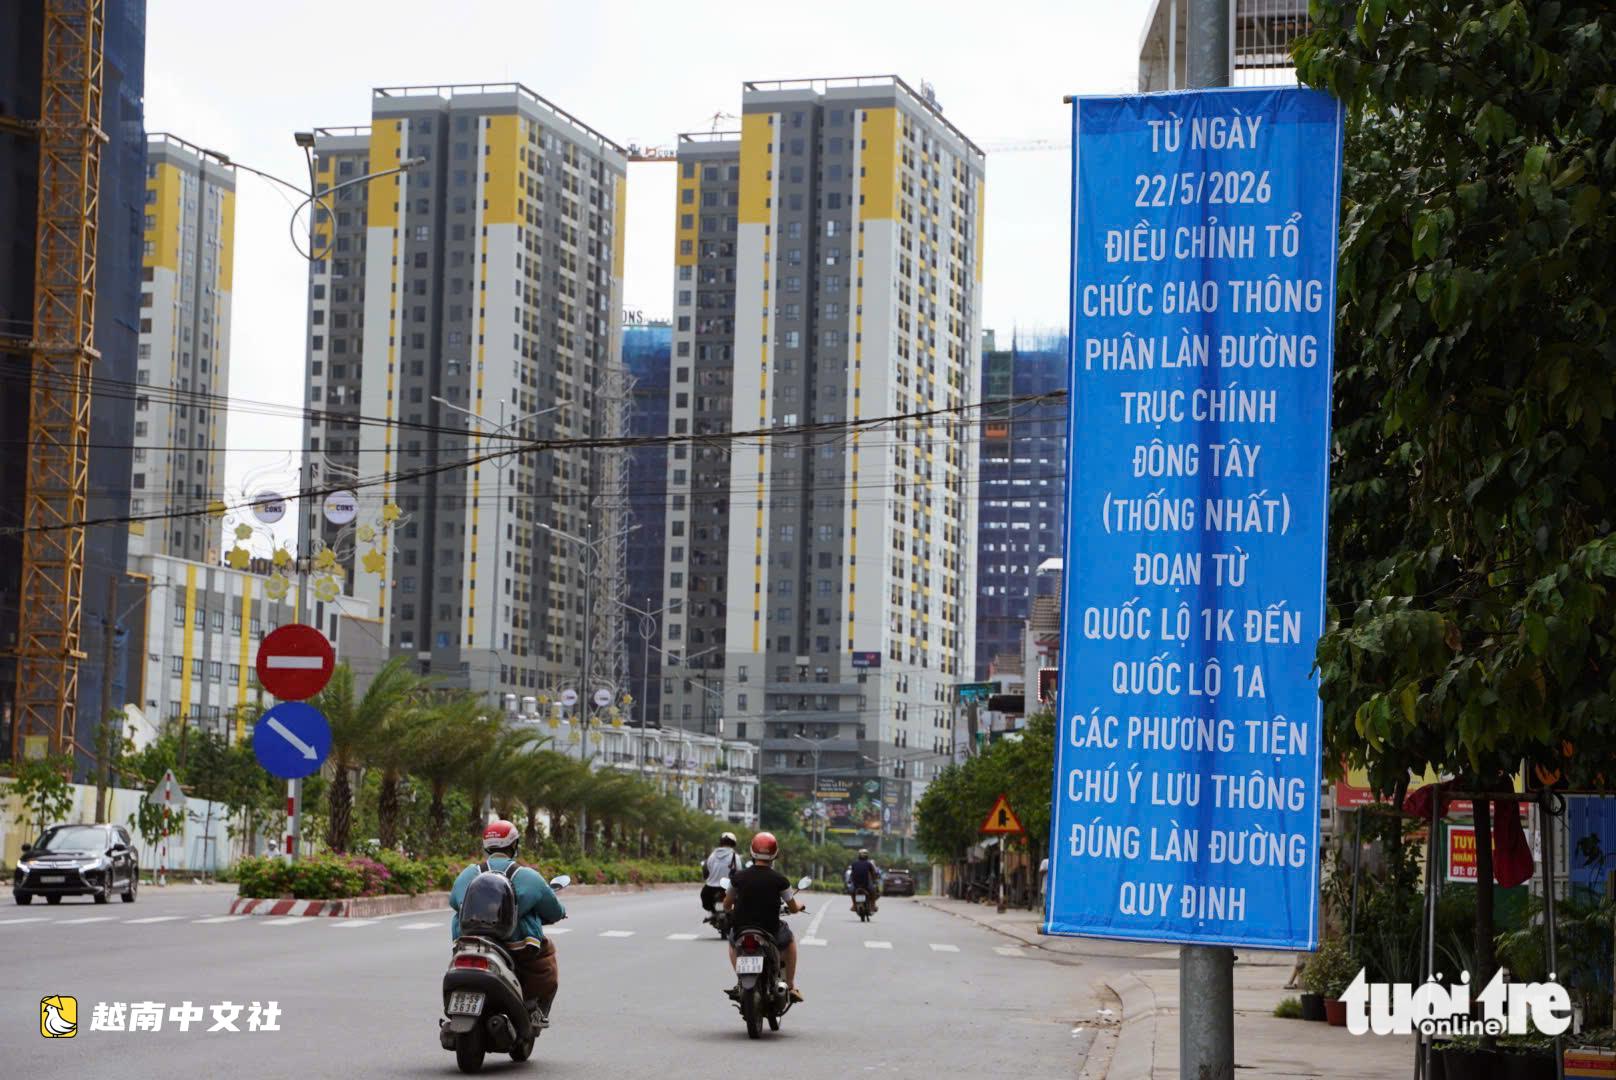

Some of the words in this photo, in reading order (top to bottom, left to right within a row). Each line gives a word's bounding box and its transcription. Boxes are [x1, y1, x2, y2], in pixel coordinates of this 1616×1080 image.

[1148, 112, 1183, 152] TỪ
[1192, 109, 1261, 149] NGÀY
[1136, 171, 1270, 206] 22/5/2026
[1105, 219, 1165, 262] ĐIỀU
[1175, 217, 1254, 259] CHỈNH
[1266, 212, 1301, 257] TỔ
[1084, 276, 1152, 316] CHỨC
[1163, 281, 1217, 313] GIAO
[1229, 274, 1322, 312] THÔNG
[1086, 332, 1154, 370] PHÂN
[1162, 328, 1208, 368] LÀN
[1219, 327, 1316, 368] ĐƯỜNG
[1121, 390, 1184, 429] TRỤC
[1192, 382, 1275, 422] CHÍNH
[1133, 438, 1198, 477] ĐÔNG
[1210, 439, 1260, 477] TÂY
[1103, 488, 1194, 533] (THỐNG
[1206, 490, 1290, 535] NHẤT)
[1133, 553, 1201, 592] ĐOẠN
[1213, 546, 1249, 586] TỪ
[1084, 597, 1151, 640] QUỐC
[1162, 602, 1190, 647] LỘ
[1202, 609, 1234, 641] 1K
[1244, 601, 1300, 643] ĐẾN
[1113, 652, 1181, 695] QUỐC
[1189, 658, 1220, 703] LỘ
[1234, 665, 1265, 698] 1A
[1071, 707, 1118, 748] CÁC
[1128, 716, 1234, 752] PHƯƠNG
[1245, 715, 1307, 761] TIỆN
[1069, 763, 1118, 803] CHÚ
[1128, 763, 1142, 803] Ý
[1152, 772, 1200, 806] LƯU
[1211, 770, 1304, 811] THÔNG
[1069, 817, 1140, 859] ĐÚNG
[1151, 820, 1198, 862] LÀN
[1209, 824, 1305, 867] ĐƯỜNG
[1120, 882, 1173, 916] QUY
[1181, 885, 1245, 926] ĐỊNH
